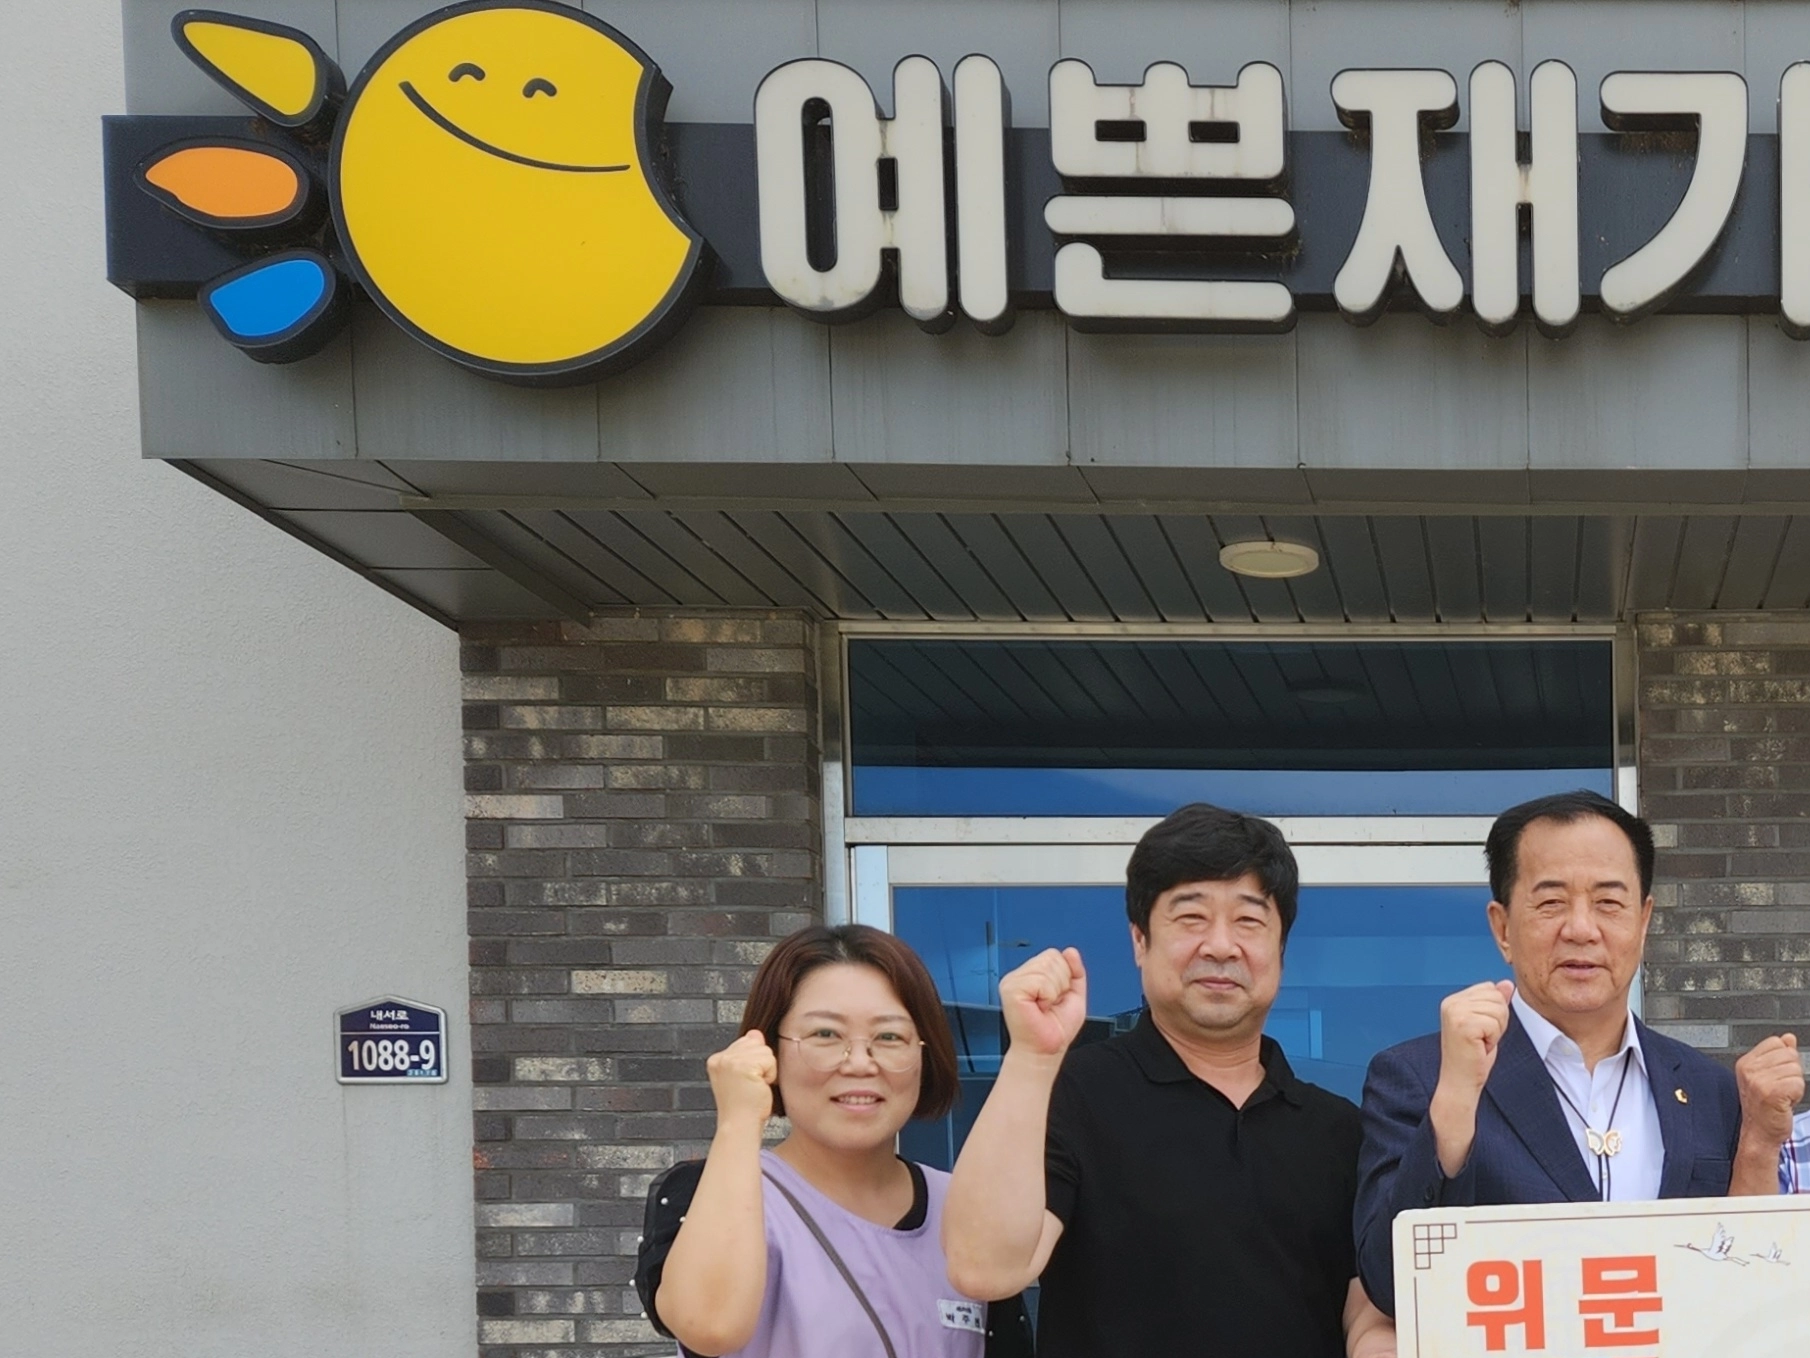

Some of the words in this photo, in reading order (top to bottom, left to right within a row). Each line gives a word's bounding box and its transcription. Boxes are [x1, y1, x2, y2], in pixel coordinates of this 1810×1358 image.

[370, 1009, 409, 1020] 내서로
[348, 1039, 435, 1071] 1088-9
[1465, 1259, 1546, 1352] 위
[1577, 1255, 1663, 1349] 문
